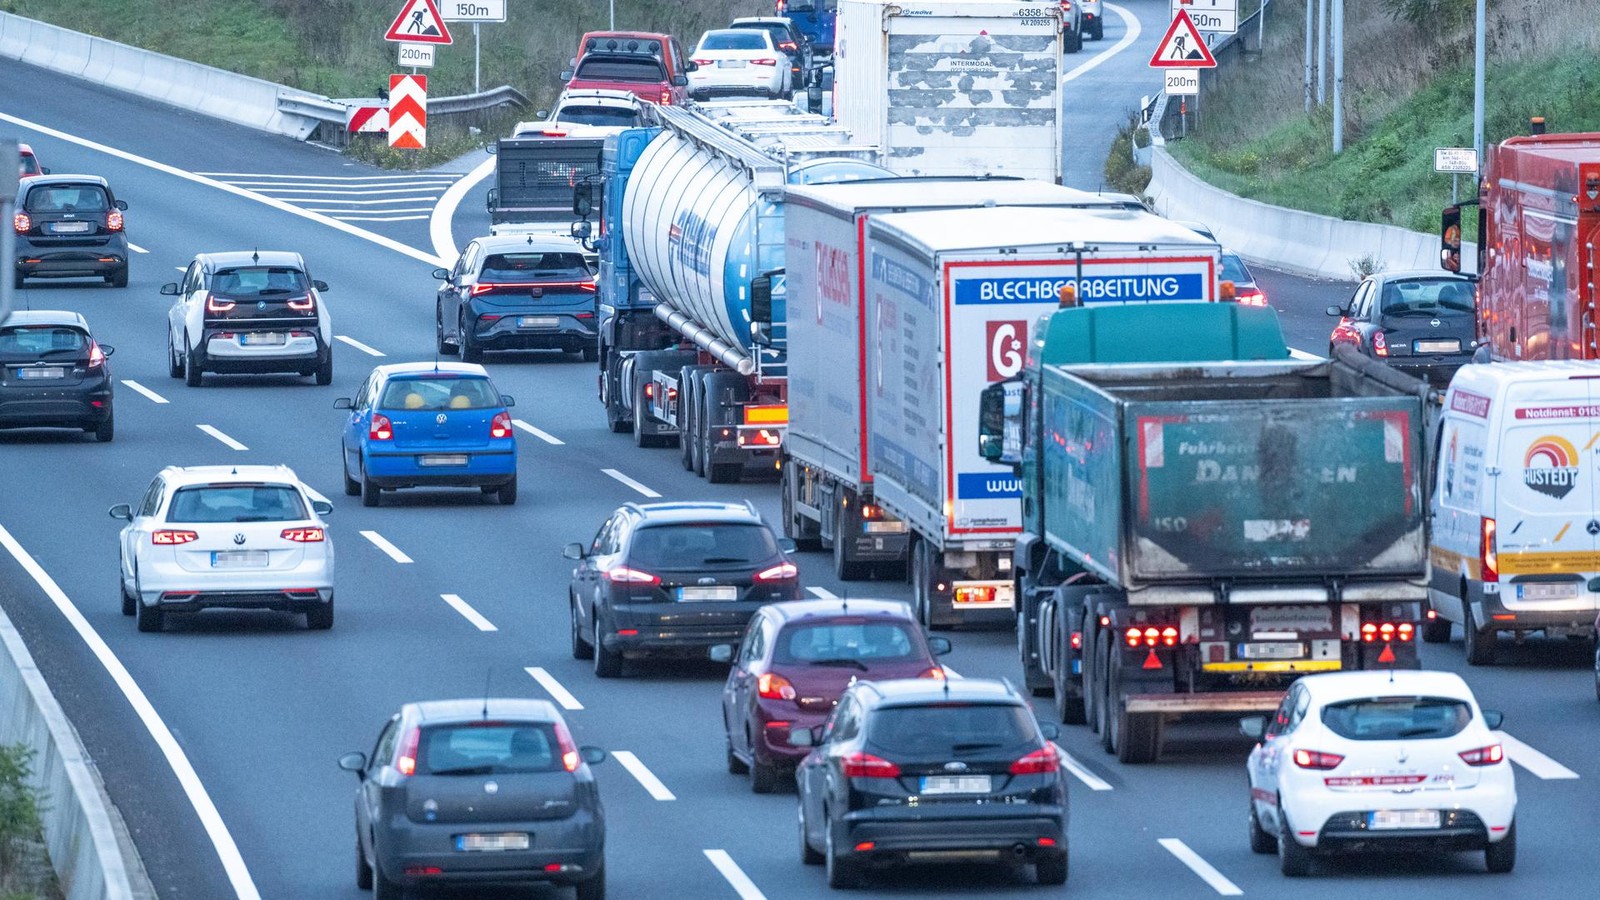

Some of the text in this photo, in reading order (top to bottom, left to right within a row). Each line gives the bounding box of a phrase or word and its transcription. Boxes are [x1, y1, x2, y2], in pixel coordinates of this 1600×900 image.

[456, 4, 489, 16] 150m
[1018, 8, 1042, 16] 6358
[1189, 14, 1221, 27] 50m
[401, 49, 431, 60] 200m
[1167, 77, 1197, 87] 200m
[1523, 468, 1578, 487] HUSTEDT
